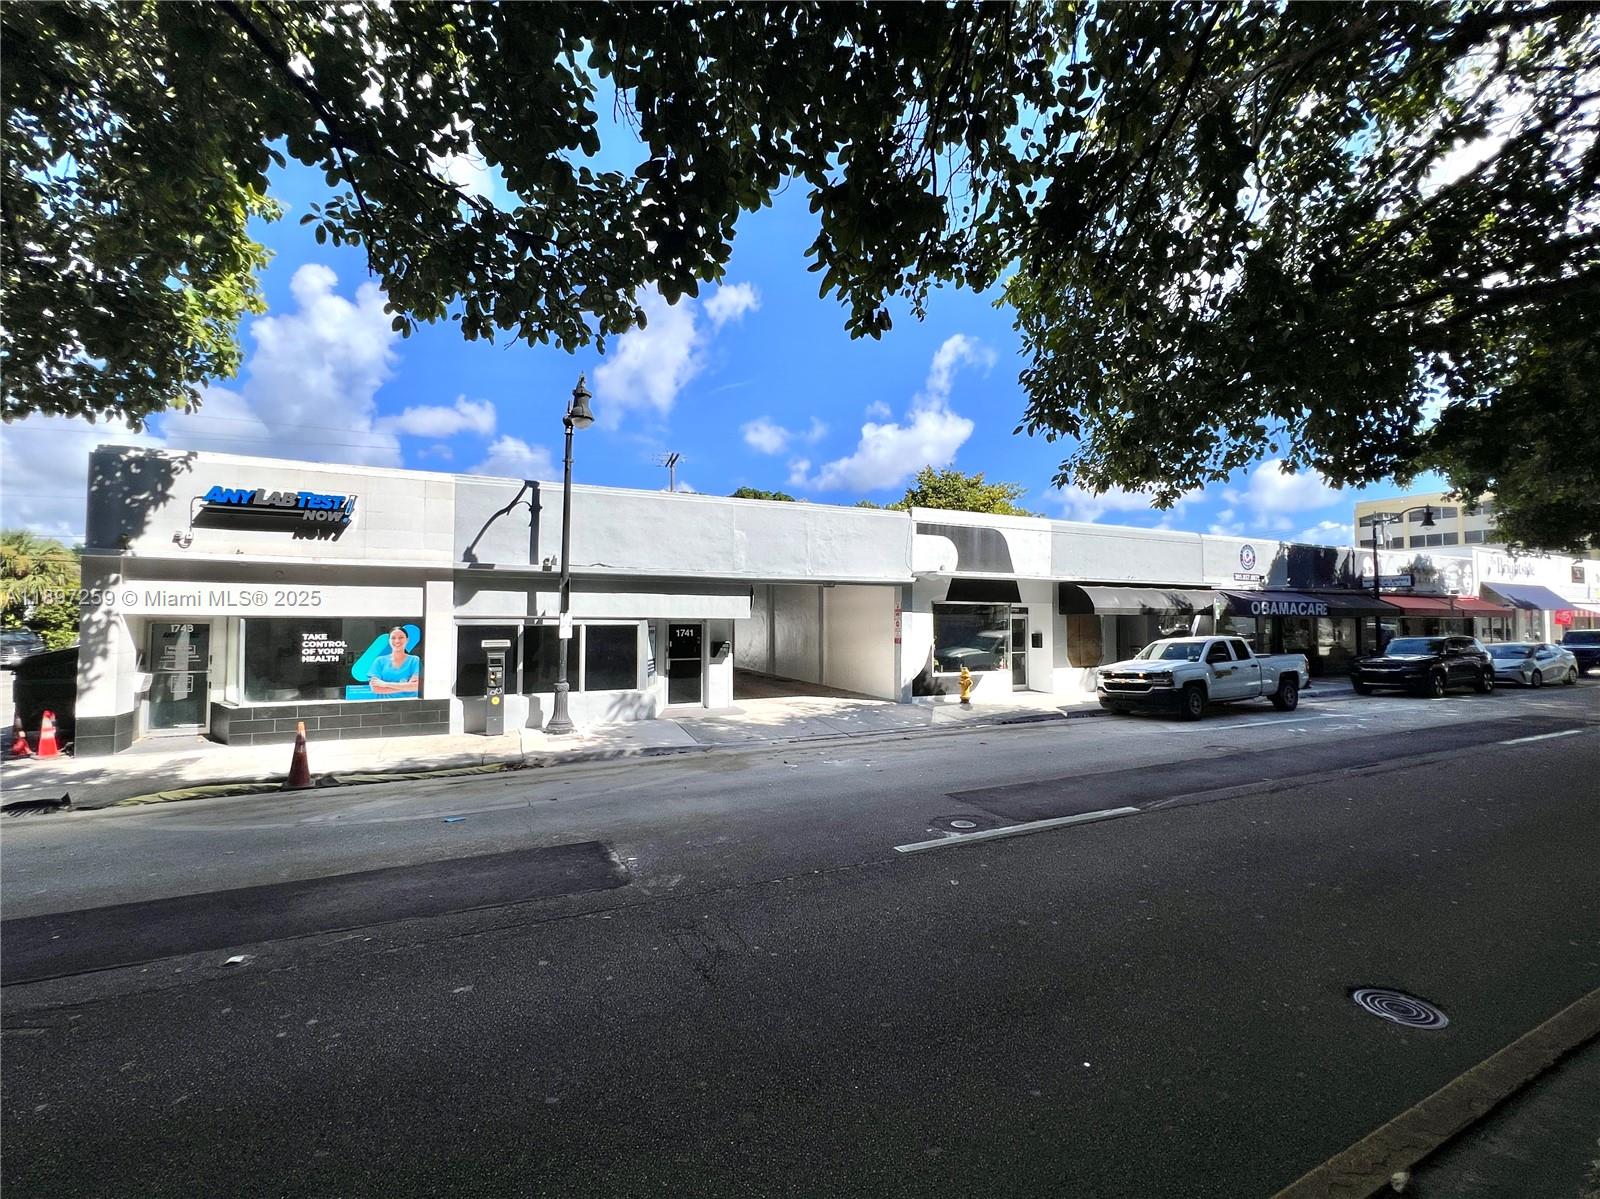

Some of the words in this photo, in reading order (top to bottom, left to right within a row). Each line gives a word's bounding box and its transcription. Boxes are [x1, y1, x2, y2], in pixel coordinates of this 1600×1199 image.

[1251, 601, 1329, 616] OBAMACARE
[170, 624, 194, 633] 1743
[302, 633, 328, 641] TAKE
[676, 629, 694, 637] 1741
[302, 640, 348, 648] CONTROL
